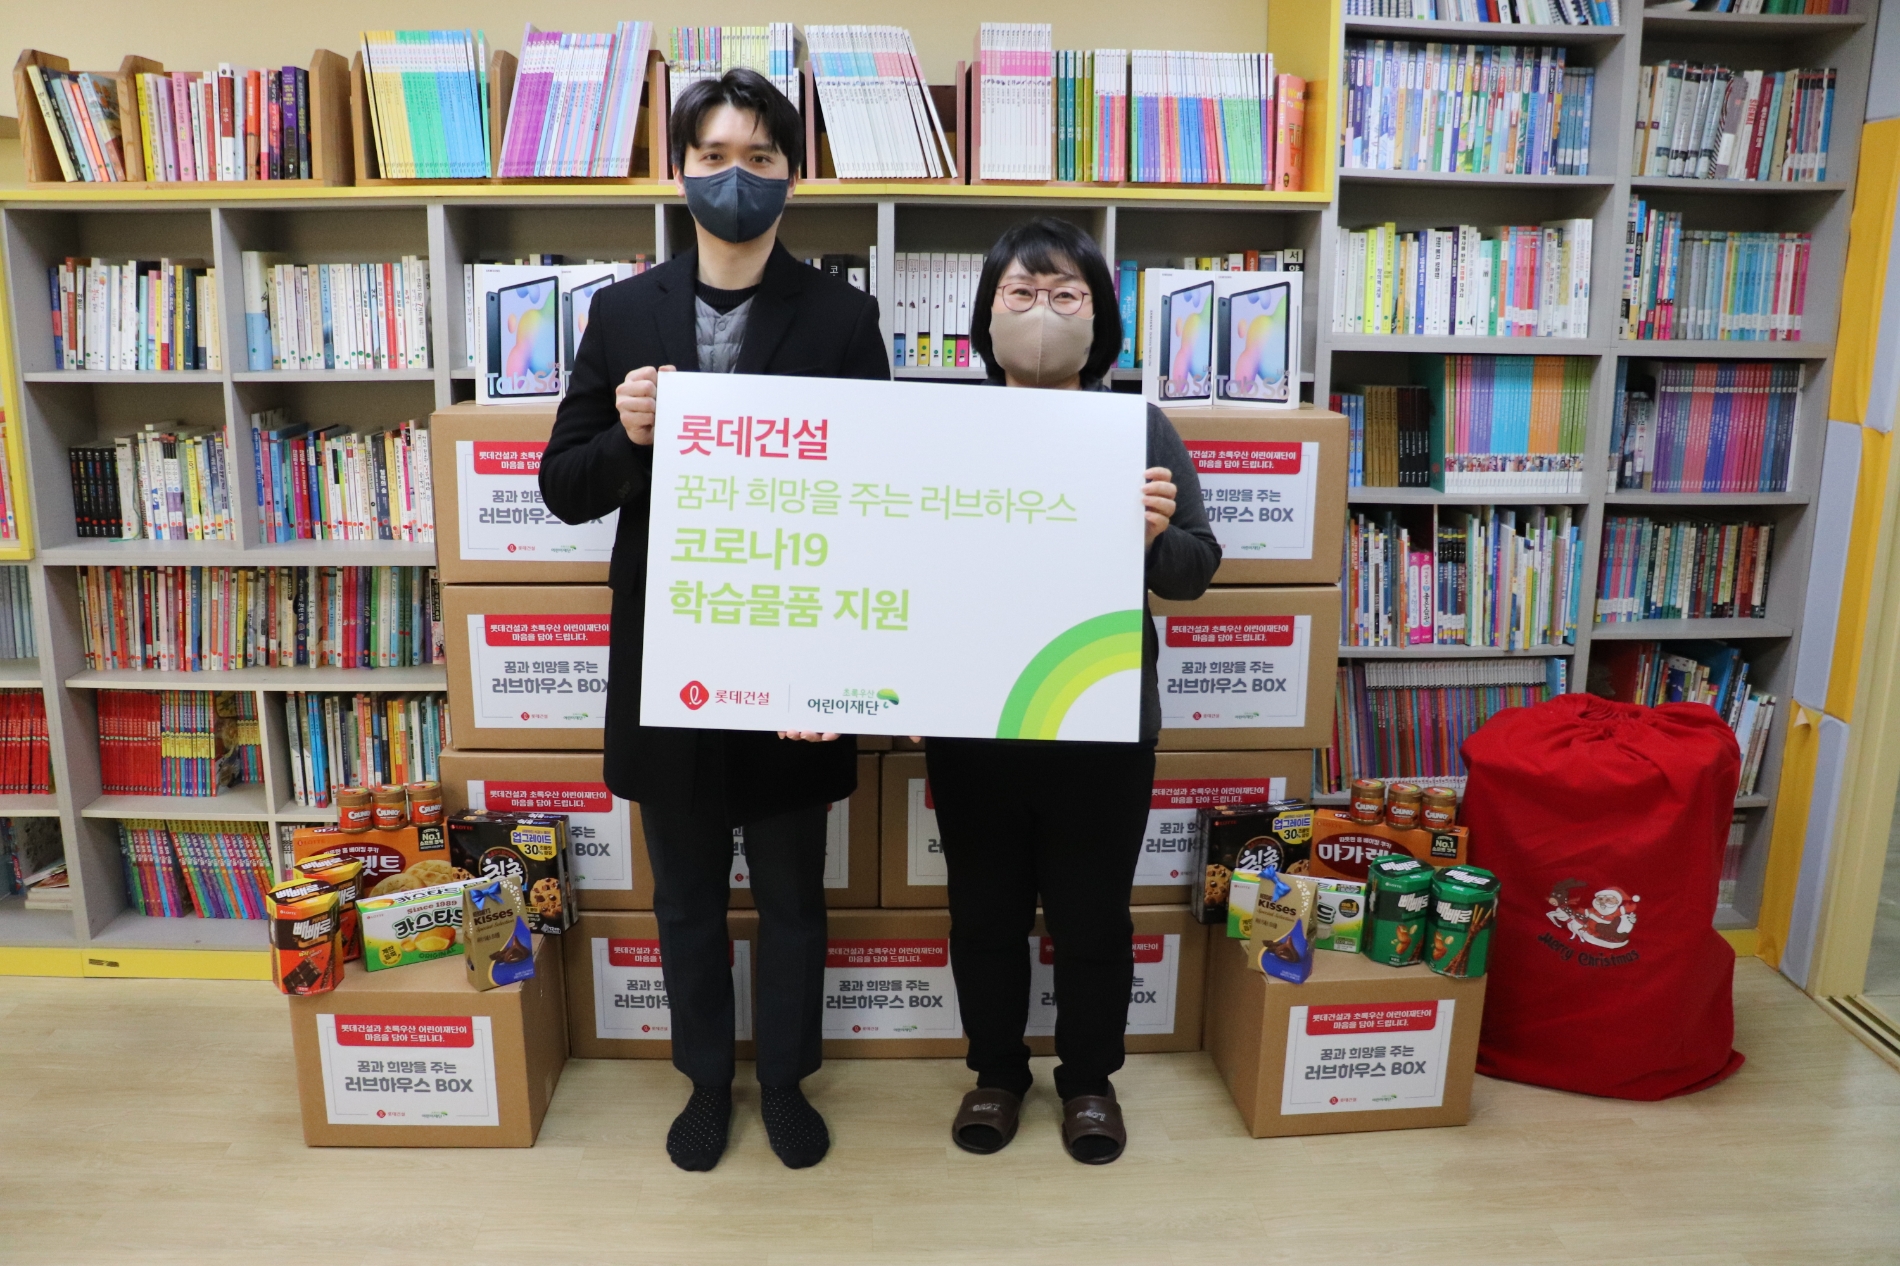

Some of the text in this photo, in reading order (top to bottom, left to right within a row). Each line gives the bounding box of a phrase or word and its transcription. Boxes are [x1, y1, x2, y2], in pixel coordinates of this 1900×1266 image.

[485, 369, 561, 395] Tab S6
[1157, 372, 1212, 397] Tab S6
[1215, 373, 1290, 400] Tab S6
[676, 415, 829, 461] 롯데건설
[479, 451, 518, 460] 롯데건설과
[1218, 451, 1296, 460] 초록우산 어린이재단이
[501, 461, 524, 469] 마음을
[1199, 460, 1274, 469] 마음을 담아 드립니다.
[492, 490, 517, 503] 꿈과
[674, 475, 1078, 524] 꿈과 희망을 주는 러브하우스
[1216, 489, 1281, 502] 희망을 주는
[1259, 508, 1294, 522] BOX
[670, 527, 829, 570] 코로나19
[668, 580, 910, 631] 학습물품 지원
[490, 624, 610, 632] 롯데건설과 초록우산 어린이재단이
[1172, 625, 1288, 633] 롯데건설과 초록우산 어린이재단이
[512, 633, 588, 642] 마음을 담아 드립니다.
[1235, 634, 1267, 642] 드립니다.
[504, 661, 598, 674] 꿈과 희망을 주는
[1182, 661, 1274, 674] 꿈과 희망을 주는
[492, 678, 573, 694] 러브하우스
[1167, 678, 1287, 694] 러브하우스 BOX
[714, 689, 770, 706] 롯데건설
[842, 688, 875, 698] 초록우산
[807, 697, 879, 716] 어린이재단
[490, 790, 607, 799] 롯데건설과 초록우산 어린이재단이
[1221, 787, 1264, 795] 어린이재단이
[554, 800, 586, 808] 드립니다.
[1196, 796, 1210, 804] 담아
[376, 808, 400, 816] CRUNKY
[419, 805, 441, 813] CRUNKY
[1355, 802, 1379, 811] CRUNKY
[1391, 806, 1414, 816] CRUNKY
[348, 811, 371, 819] CRUNKY
[1425, 810, 1448, 819] CRUNKY
[1160, 822, 1184, 835] 꿈과
[1274, 818, 1311, 830] 업그레이드
[513, 832, 552, 843] 업그레이드
[572, 826, 595, 838] 주는
[575, 842, 610, 856] BOX
[1436, 840, 1454, 848] No.1
[1380, 861, 1421, 871] 빼빼로
[1445, 869, 1490, 885] 빼빼로
[407, 900, 458, 914] Since 1989
[1398, 893, 1429, 912] 빼빼로
[1436, 901, 1472, 924] 빼빼로
[293, 918, 331, 940] 빼빼로
[419, 948, 456, 958] ORIGINAL
[1537, 932, 1639, 967] Merry Christmas
[627, 980, 651, 991] 꿈과
[839, 980, 930, 992] 꿈과 희망을 주는
[826, 995, 943, 1010] 러브하우스 BOX
[1312, 1010, 1431, 1022] 롯데건설과 초록우산 어린이재단이
[342, 1024, 467, 1034] 롯데건설과 초록우산 어린이재단이
[1333, 1019, 1409, 1029] 마음을 담아 드립니다.
[365, 1034, 445, 1043] 마음을 담아 드립니다.
[1321, 1045, 1414, 1061] 꿈과 희망을 주는
[358, 1060, 457, 1074] 꿈과 희망을 주는
[1305, 1061, 1426, 1080] 러브하우스 BOX
[345, 1077, 474, 1093] 러브하우스 BOX
